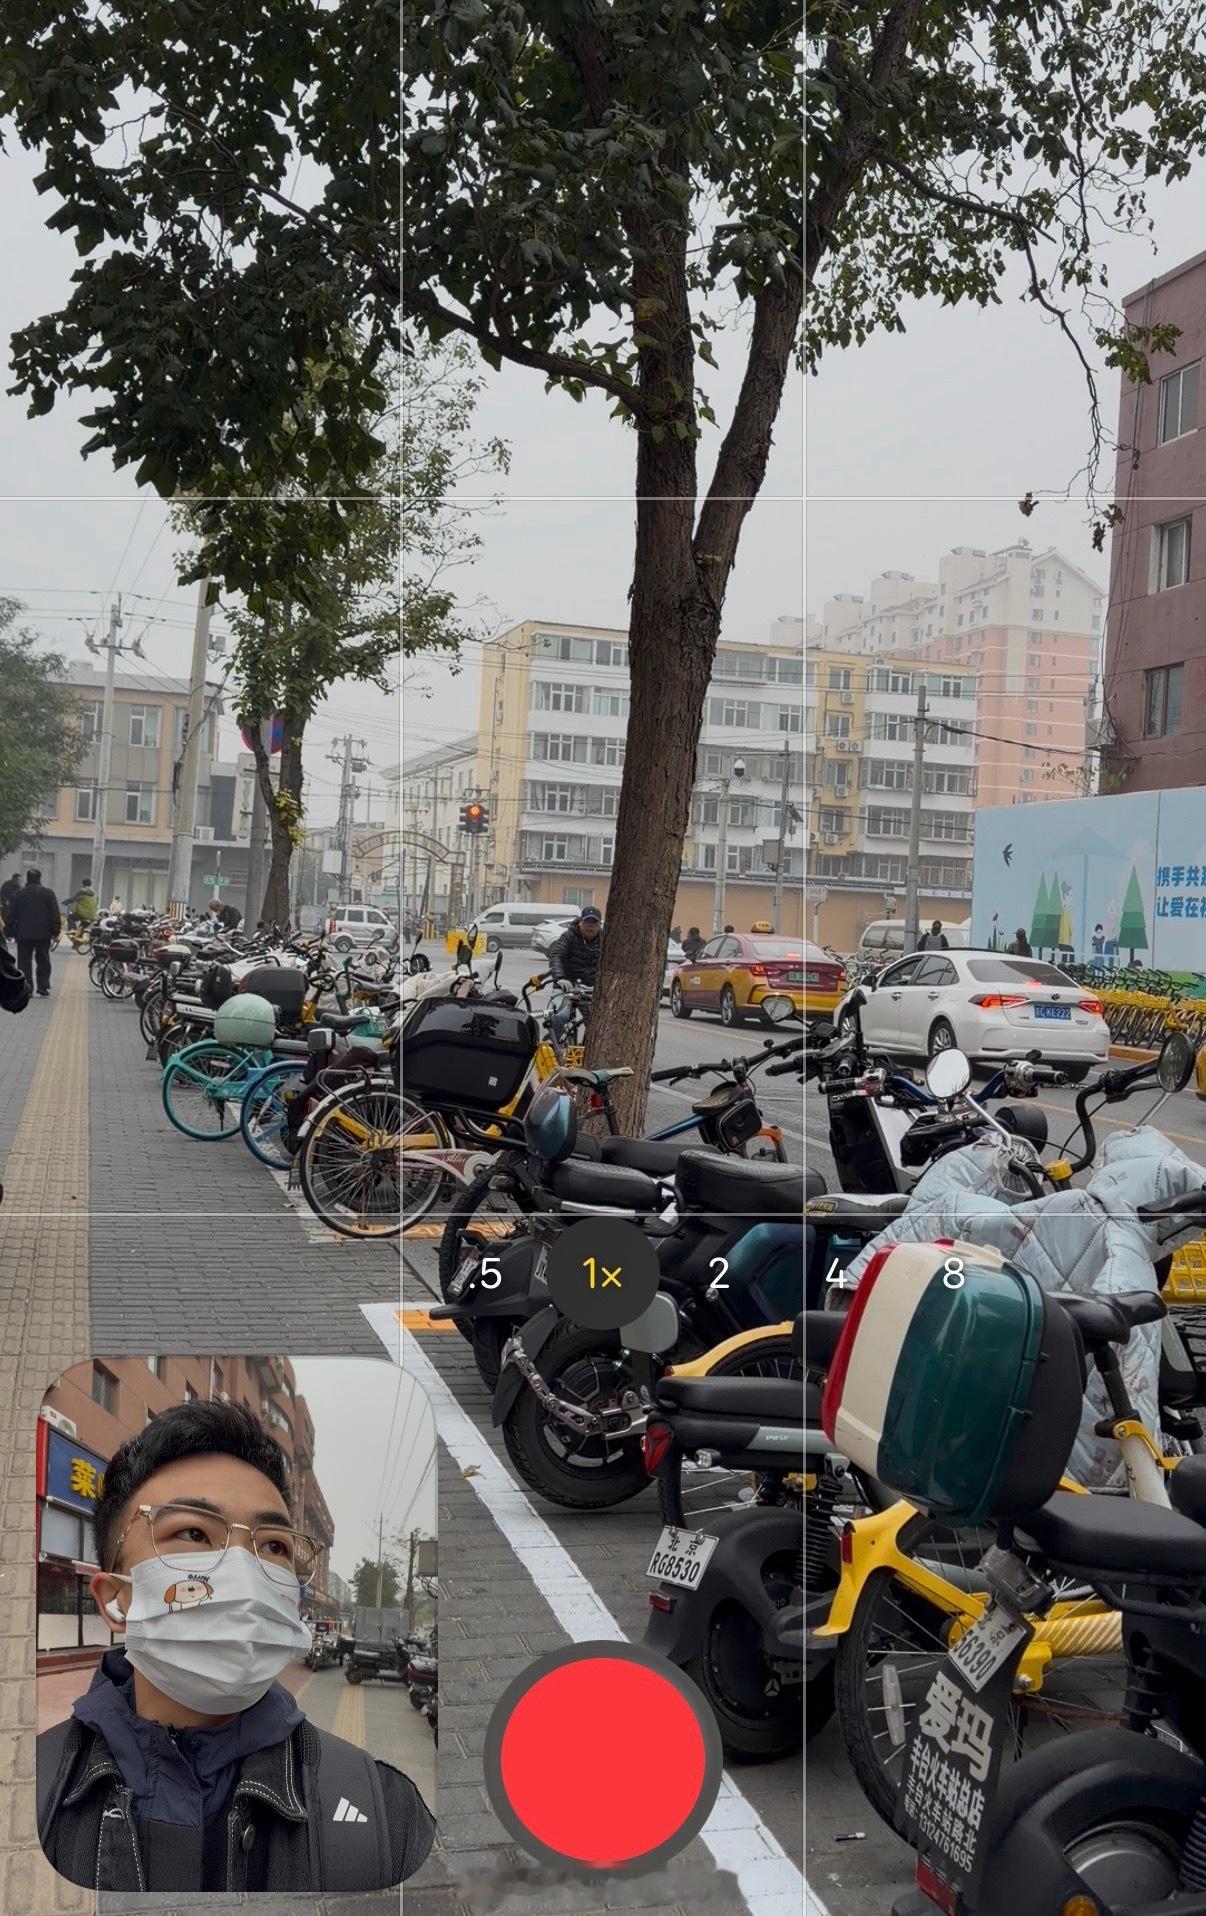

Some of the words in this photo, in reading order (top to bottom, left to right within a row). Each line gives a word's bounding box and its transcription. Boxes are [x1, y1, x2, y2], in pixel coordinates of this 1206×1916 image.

[649, 1551, 701, 1583] RG8530
[918, 1669, 995, 1783] 爱玛
[910, 1734, 986, 1832] 丰台火车站总店
